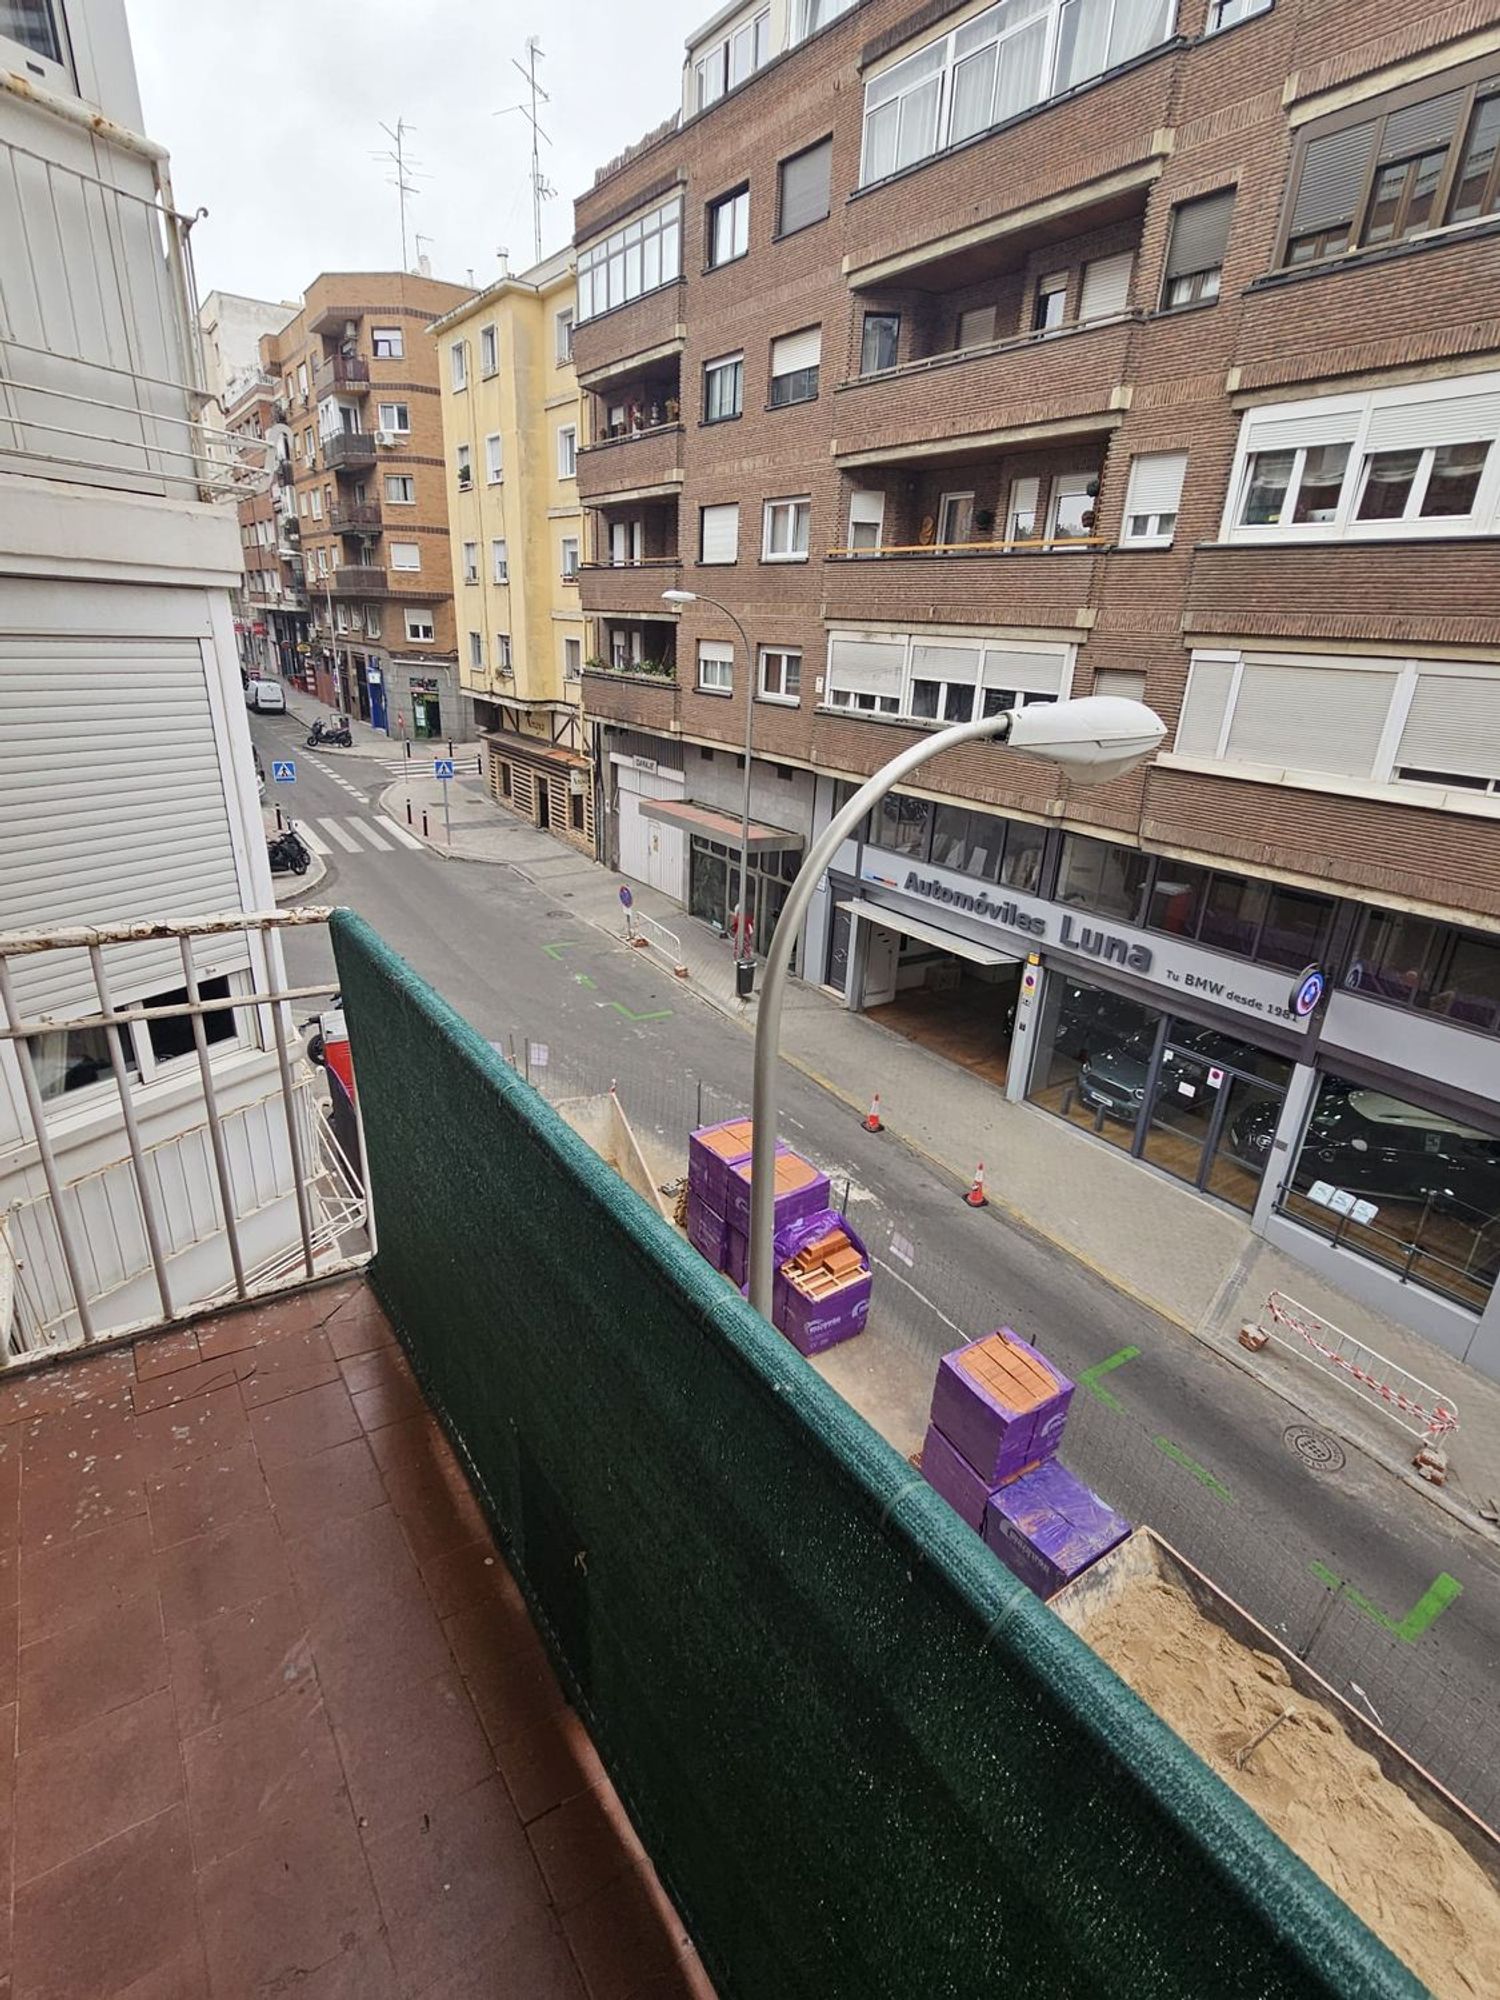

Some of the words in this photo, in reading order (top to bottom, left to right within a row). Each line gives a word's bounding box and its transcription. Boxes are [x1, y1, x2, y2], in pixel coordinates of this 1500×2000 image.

[904, 871, 1046, 935] Automóviles
[1059, 914, 1154, 973] Luna
[1166, 969, 1180, 982] Tu
[1184, 973, 1224, 996] BMW
[1226, 990, 1263, 1012] desde
[1267, 1003, 1299, 1023] 1981
